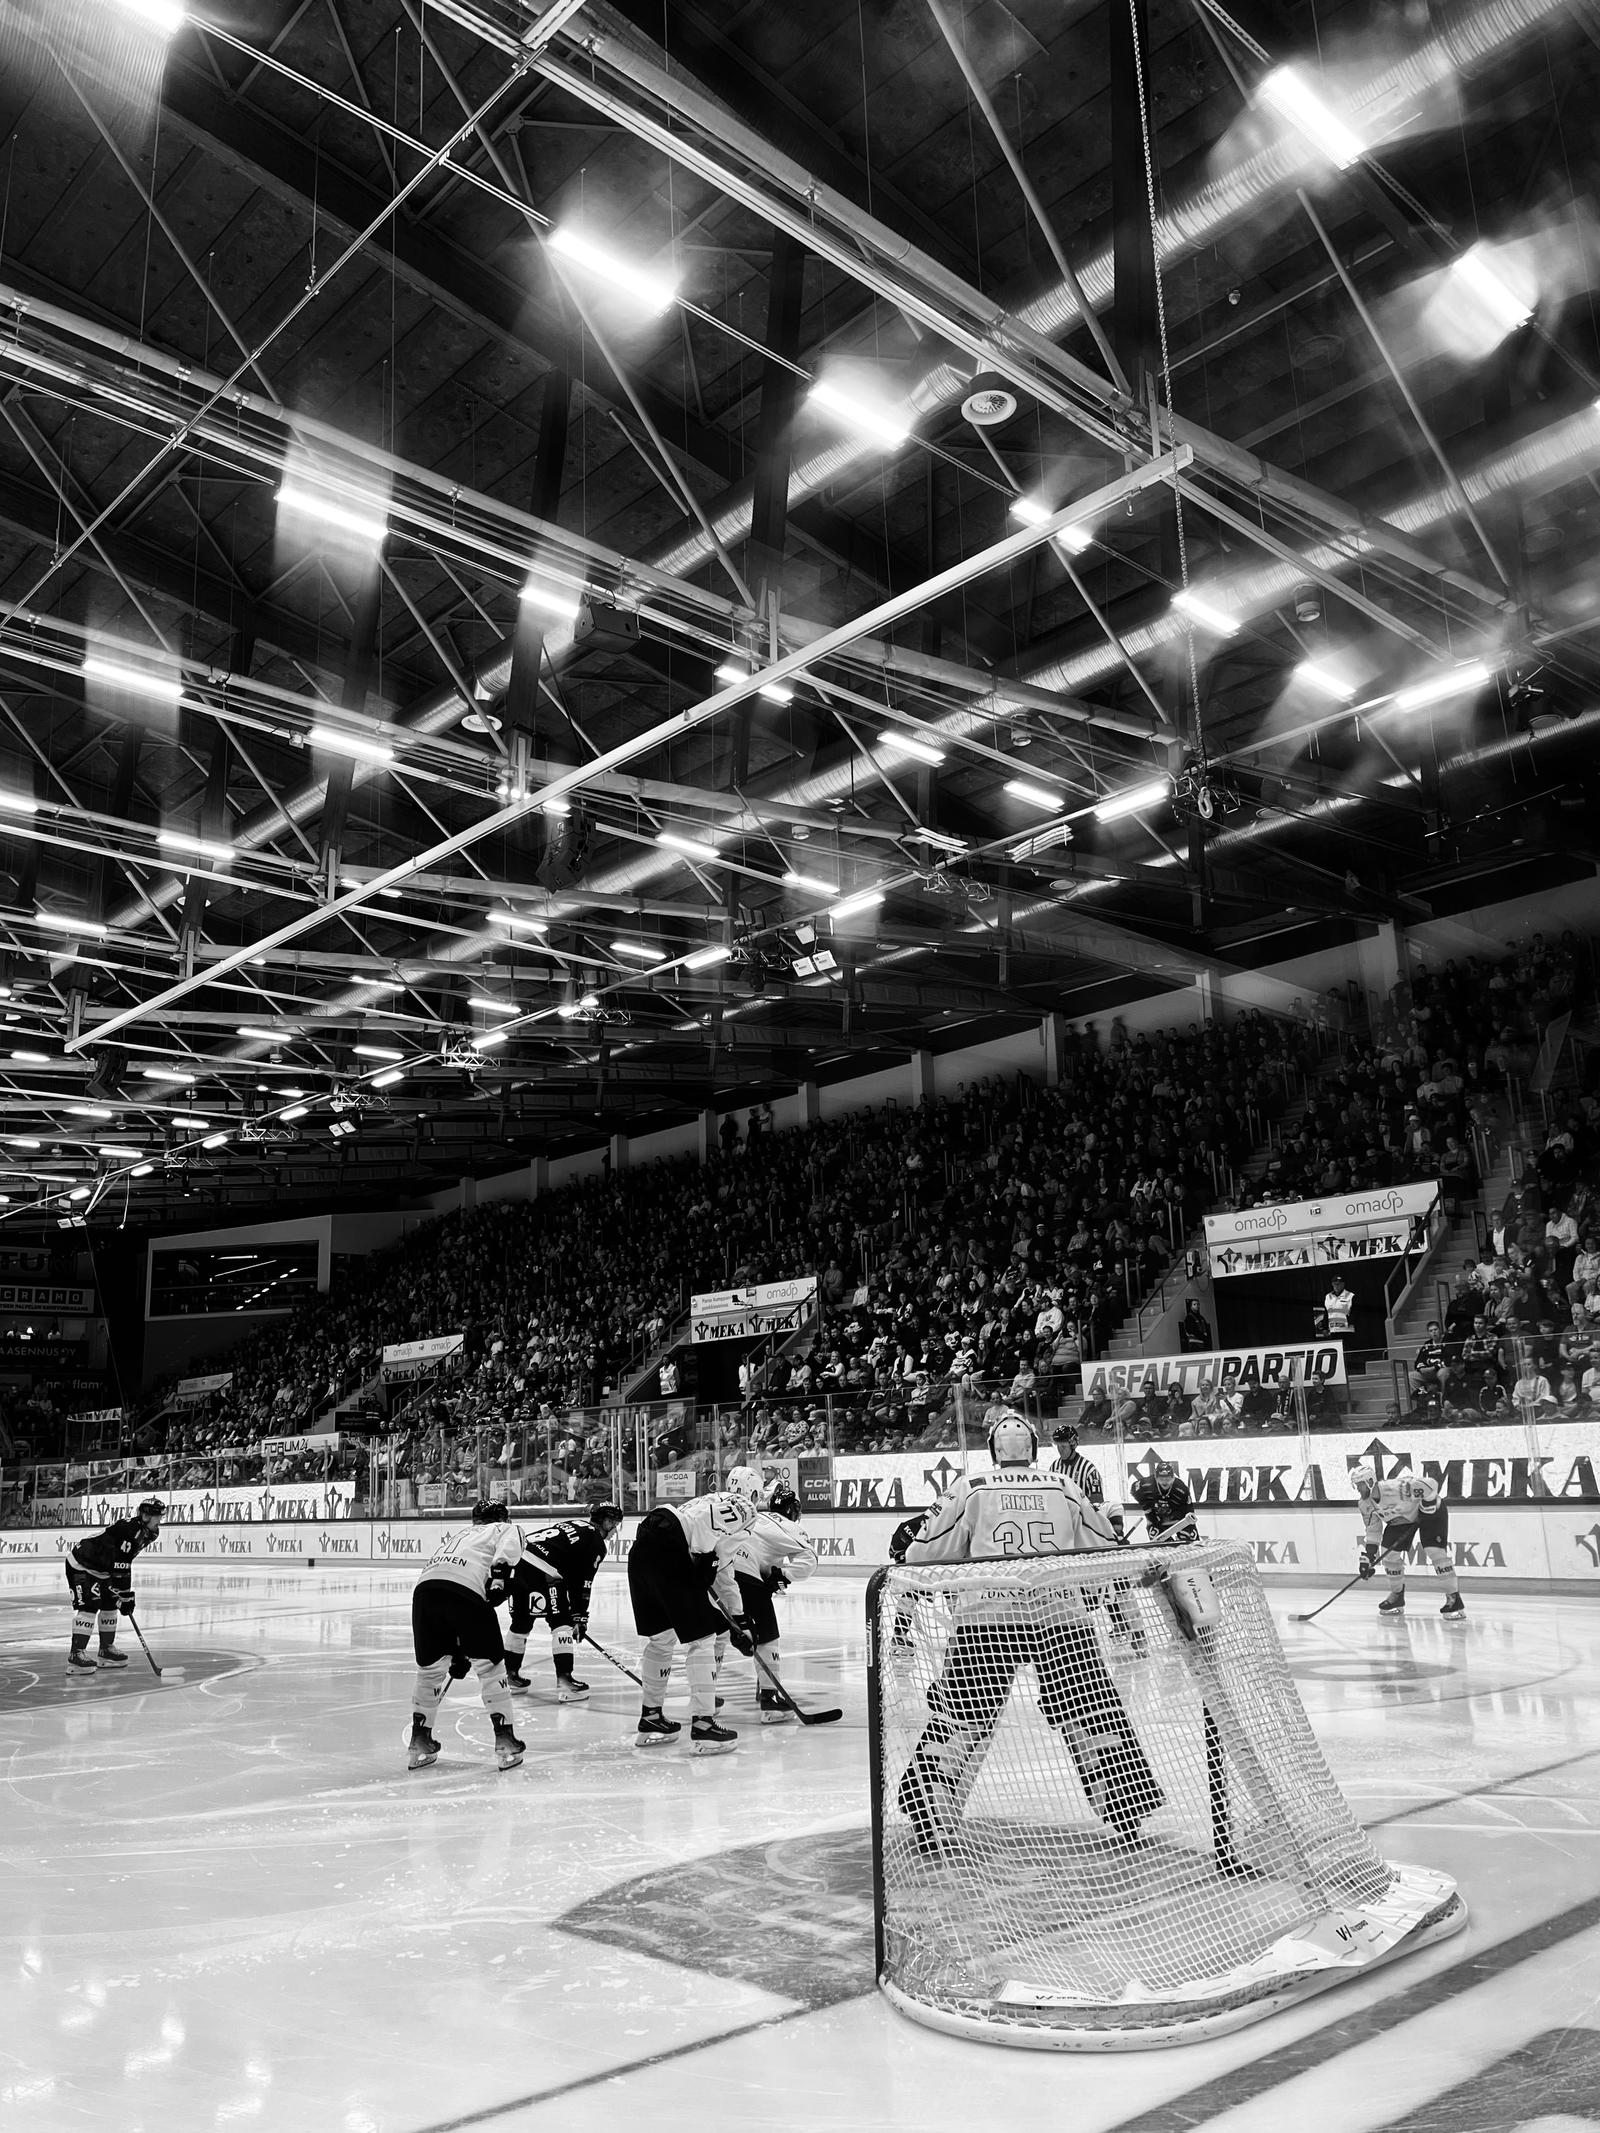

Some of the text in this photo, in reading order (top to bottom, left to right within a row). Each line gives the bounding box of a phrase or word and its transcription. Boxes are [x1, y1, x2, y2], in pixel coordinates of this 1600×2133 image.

[1244, 1247, 1310, 1271] MEKA
[2, 1290, 81, 1302] CRAMO
[710, 1322, 745, 1339] MEKA
[804, 1479, 831, 1488] CCM
[1186, 1464, 1330, 1502] MEKA
[1421, 1455, 1600, 1499] MEKA
[807, 1493, 819, 1501] ALL
[1000, 1494, 1045, 1511] RINNE
[111, 1506, 138, 1523] MEK
[165, 1504, 194, 1523] EKA
[217, 1501, 252, 1521] MEKA
[276, 1499, 318, 1520] MEKA
[7, 1542, 39, 1553] MEKA
[183, 1541, 205, 1553] MEKA
[228, 1541, 252, 1553] MEKA
[277, 1539, 302, 1553] MEKA
[330, 1539, 358, 1553] MEKA
[391, 1539, 422, 1553] MEKA
[1402, 1541, 1507, 1567] MKA
[429, 1556, 467, 1567] OINEN
[549, 1586, 560, 1614] Sievi
